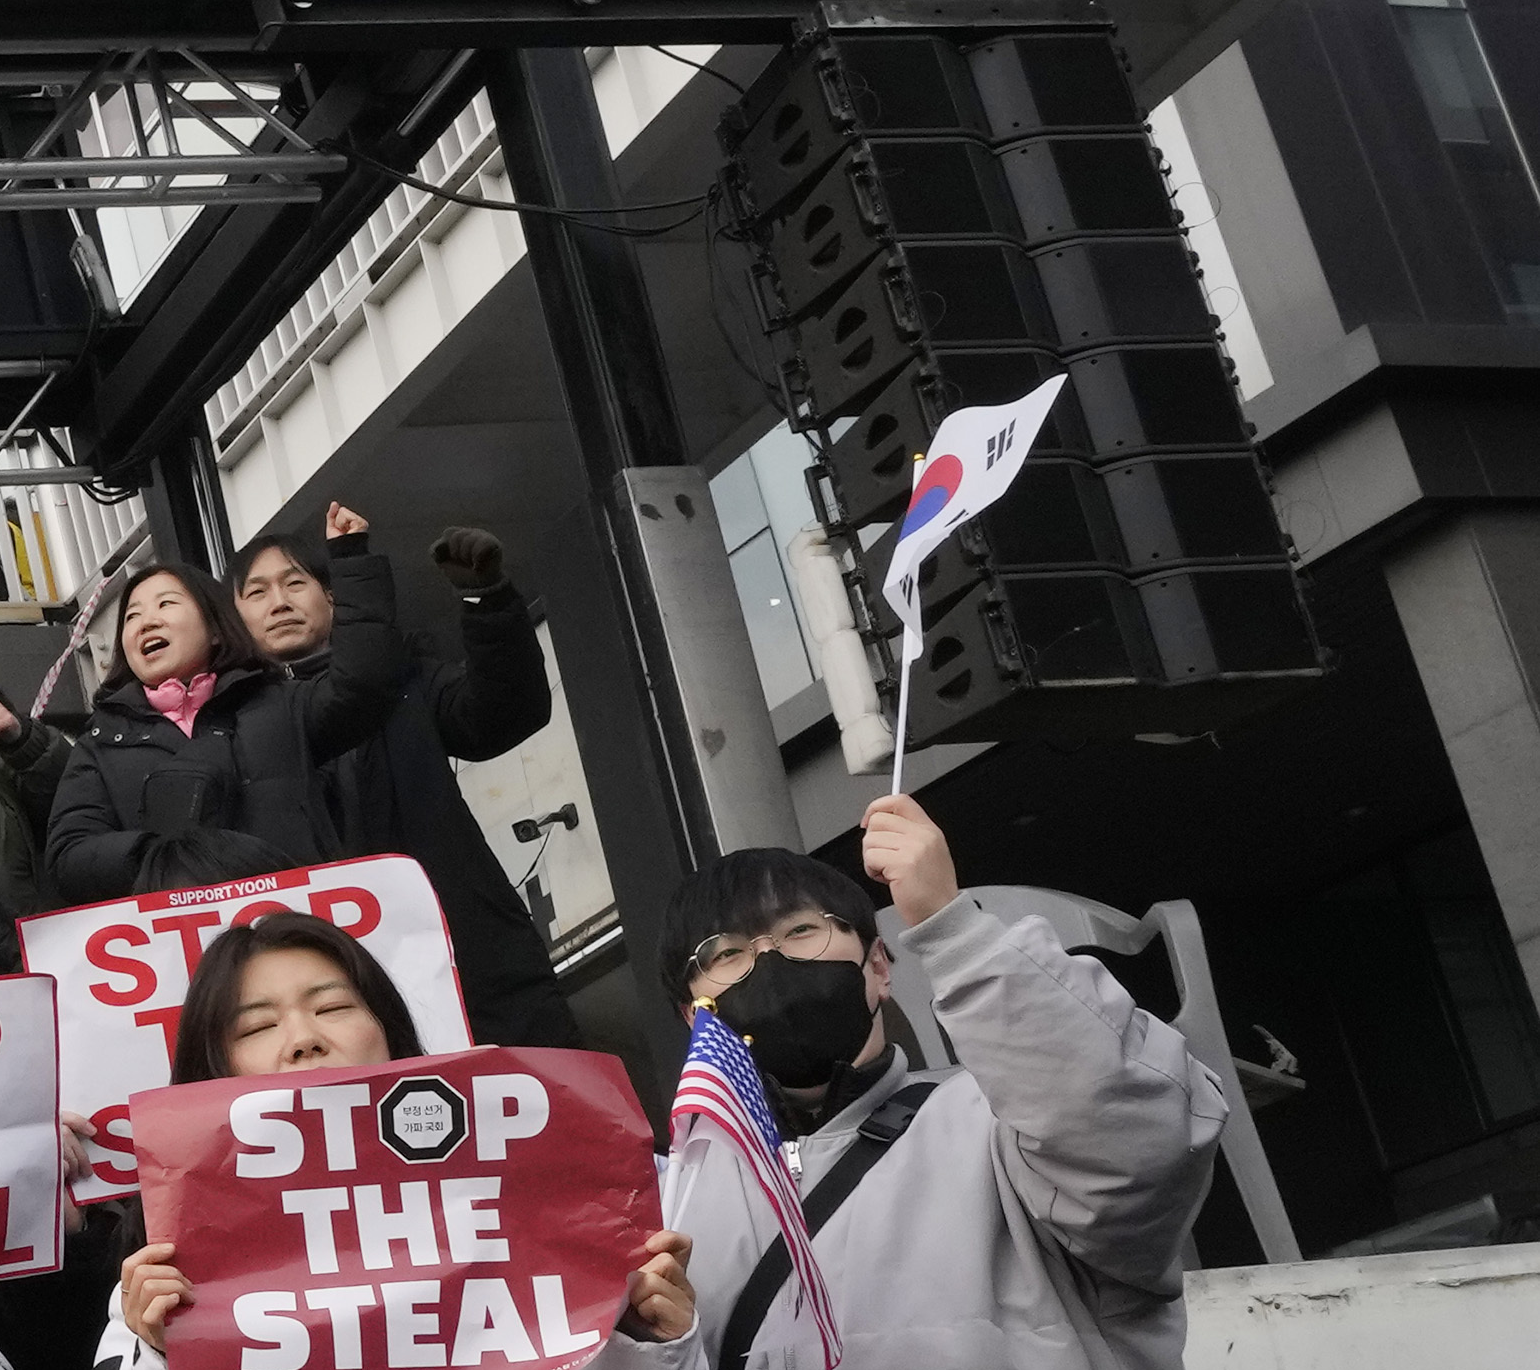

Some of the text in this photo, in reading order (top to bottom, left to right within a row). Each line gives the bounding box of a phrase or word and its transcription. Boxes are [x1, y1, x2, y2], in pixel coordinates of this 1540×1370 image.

[168, 876, 278, 906] SUPPORT YOON
[281, 1174, 511, 1276] THE
